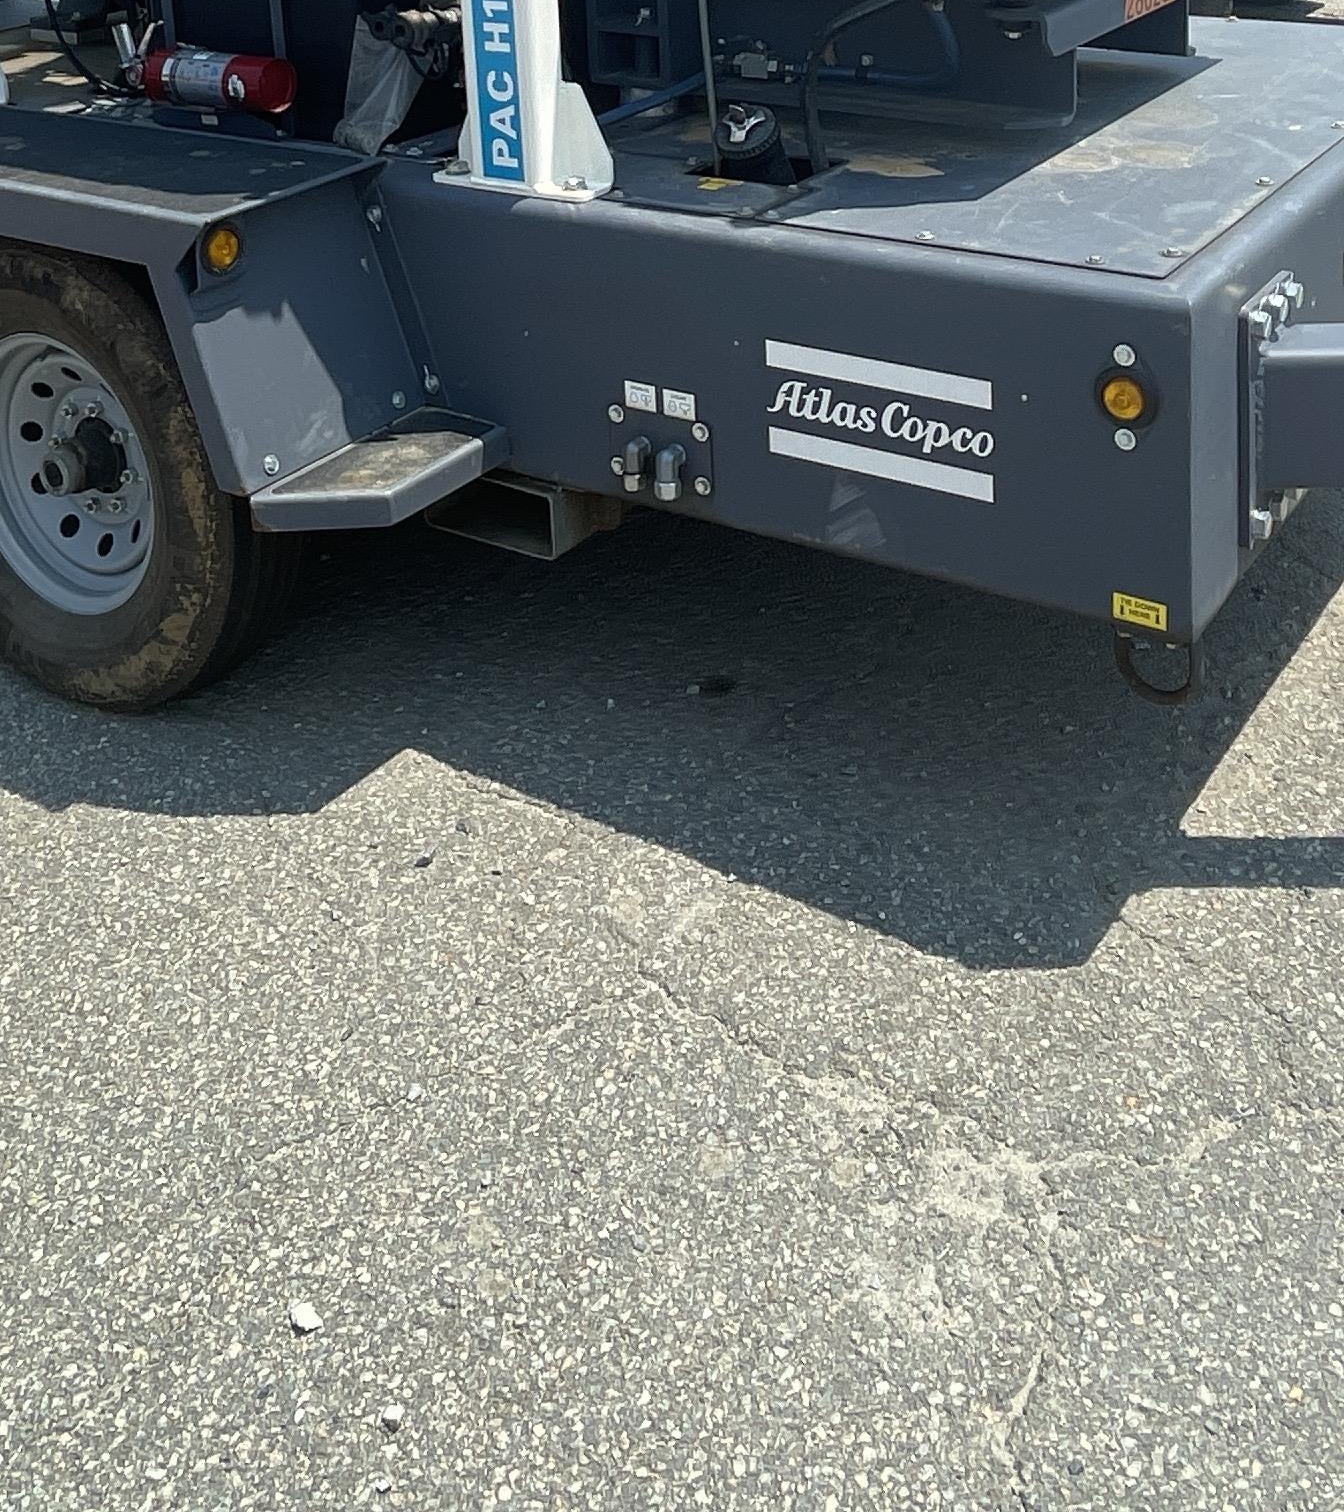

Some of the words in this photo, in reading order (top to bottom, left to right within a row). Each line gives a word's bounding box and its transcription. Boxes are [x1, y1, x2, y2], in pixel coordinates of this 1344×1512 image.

[486, 70, 519, 168] PAC
[767, 380, 878, 433] Atlas
[880, 401, 995, 458] Copco
